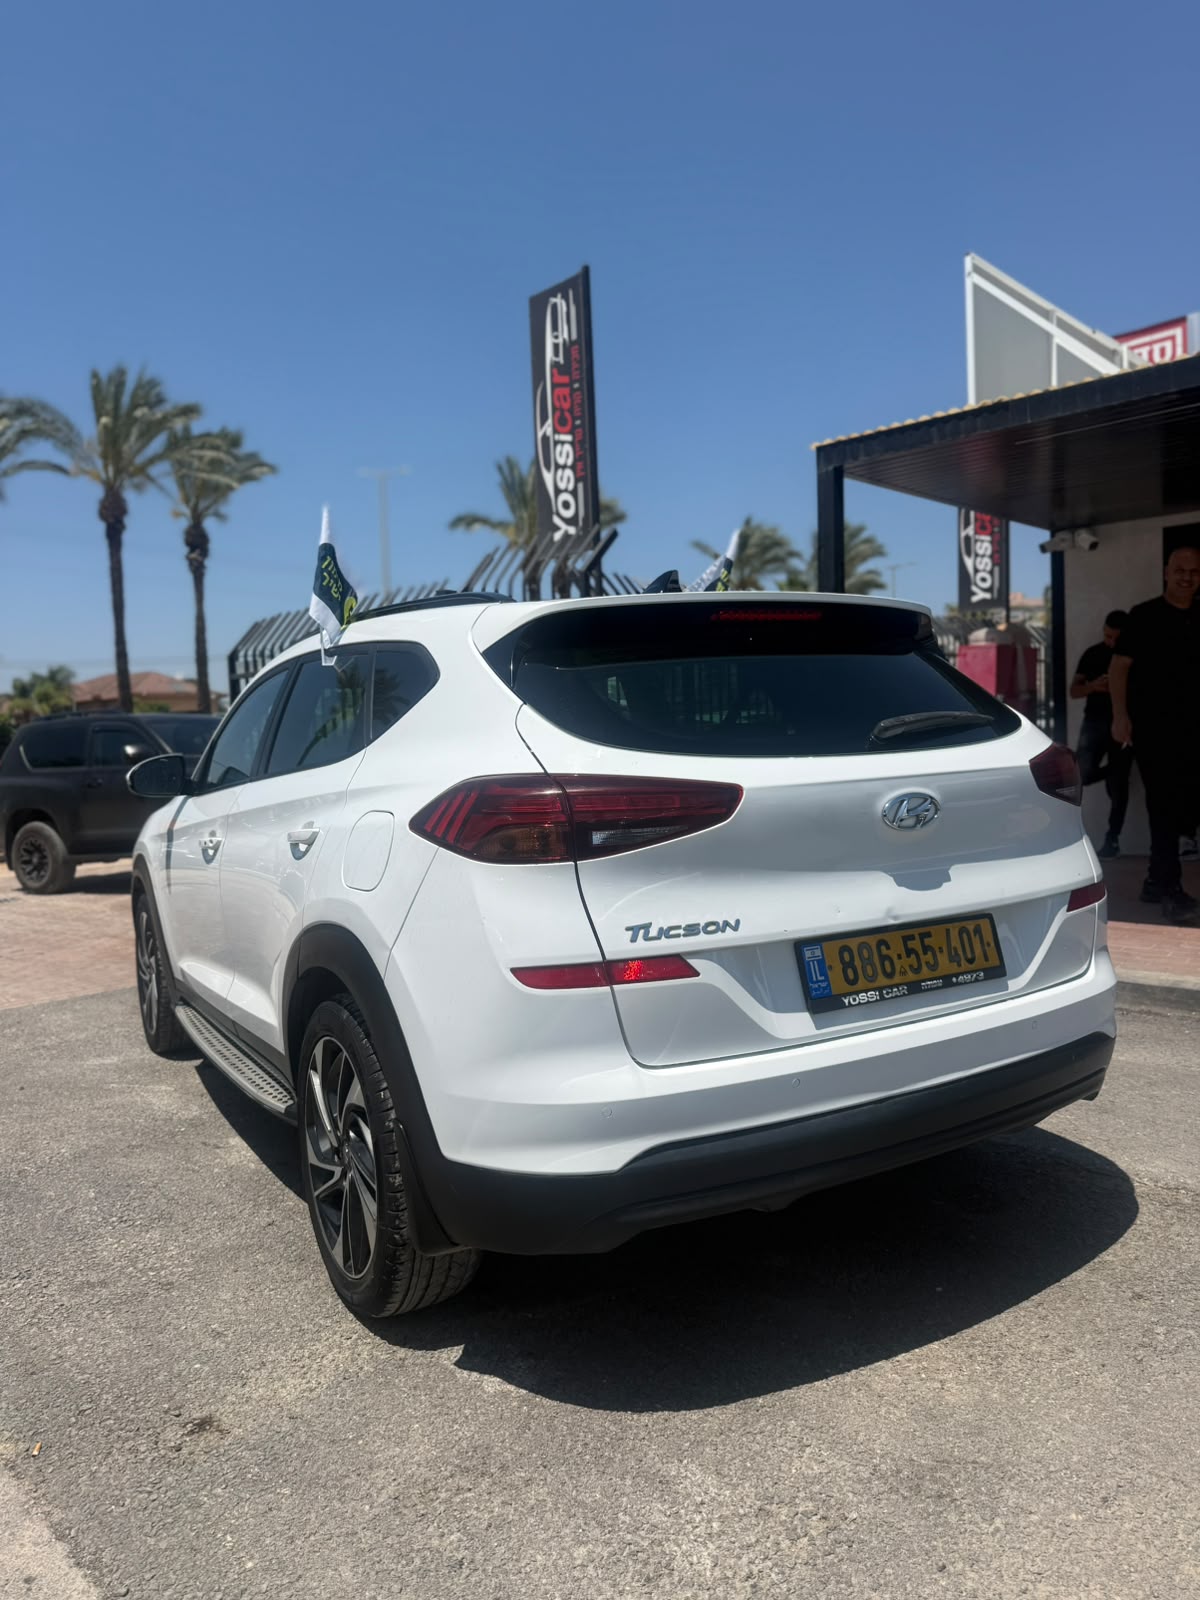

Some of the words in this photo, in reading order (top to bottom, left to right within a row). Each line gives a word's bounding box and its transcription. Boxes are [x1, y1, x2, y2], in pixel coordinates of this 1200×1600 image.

[625, 918, 741, 943] TUCSON
[809, 960, 825, 981] IL
[882, 985, 909, 999] CAR
